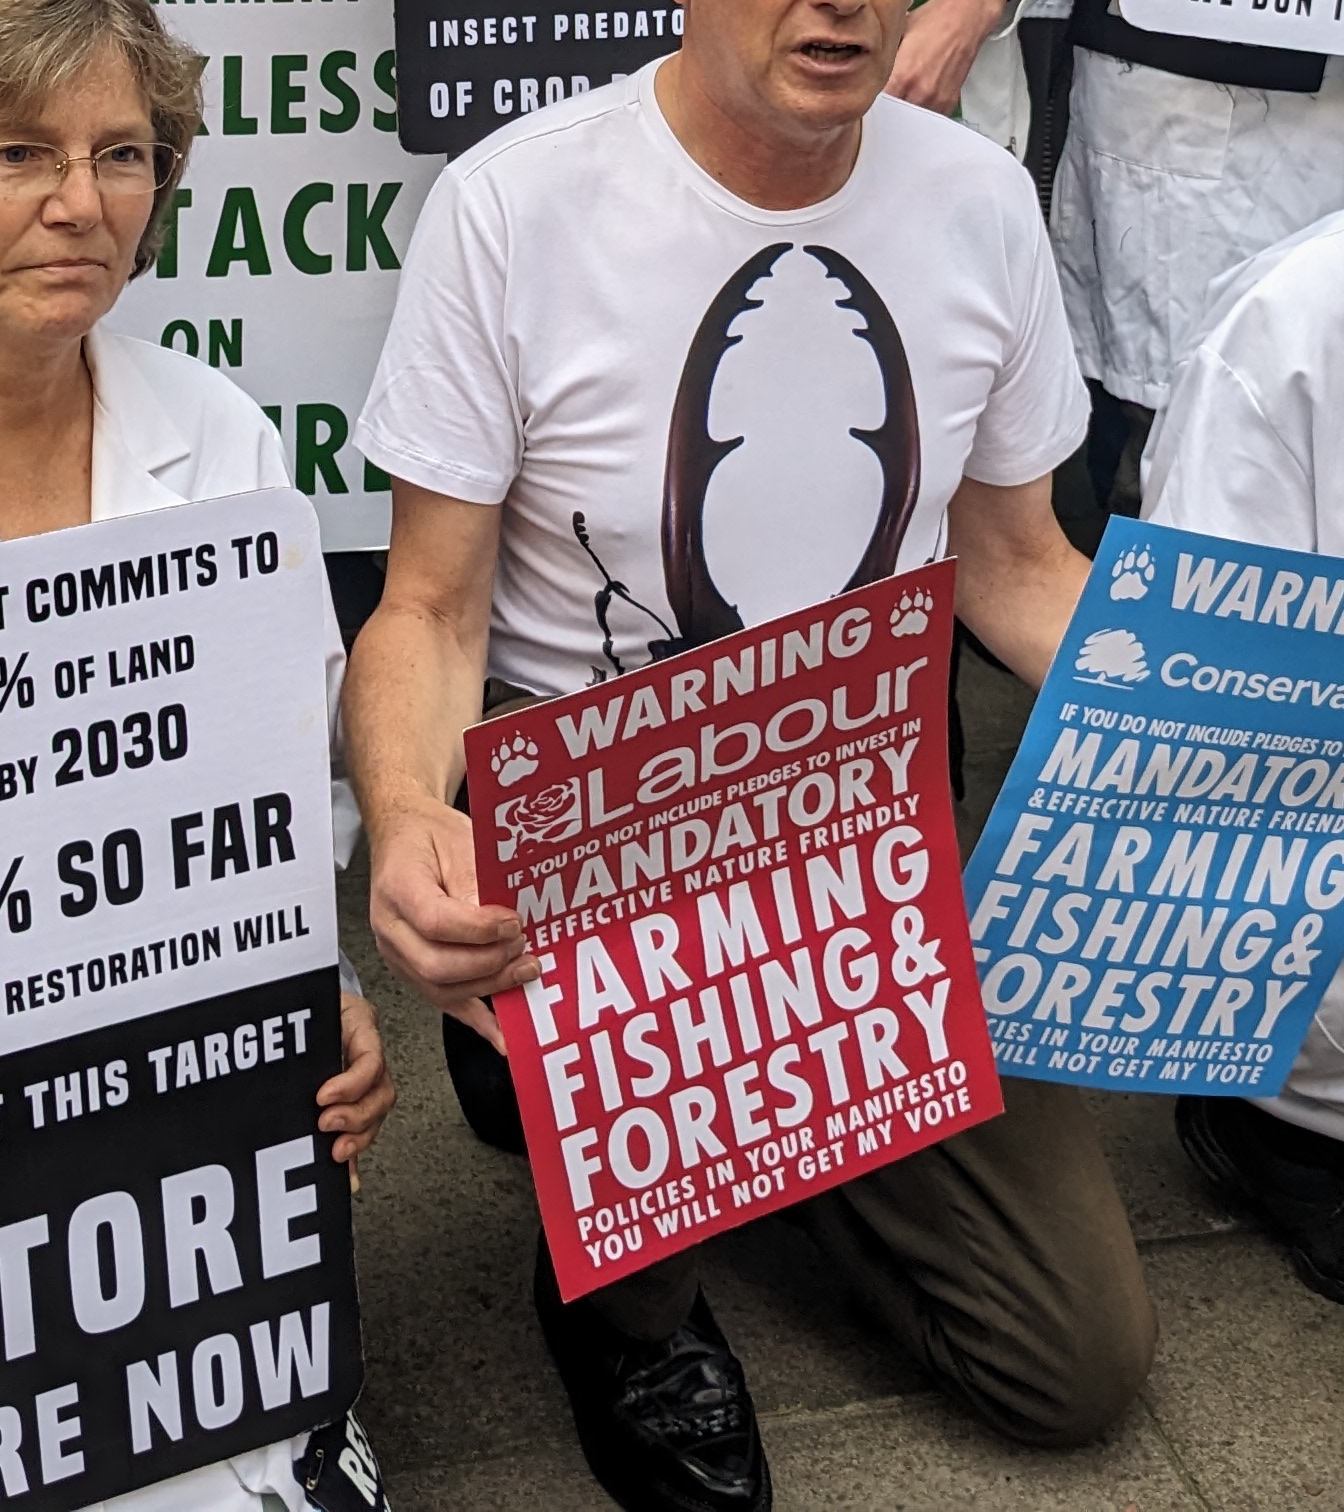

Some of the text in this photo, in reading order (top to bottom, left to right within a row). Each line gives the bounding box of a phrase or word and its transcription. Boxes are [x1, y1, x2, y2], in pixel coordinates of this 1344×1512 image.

[26, 543, 217, 623] COMMITS
[231, 531, 279, 578] TO
[556, 607, 872, 759] WARNING
[589, 656, 928, 829] Labour
[1059, 703, 1079, 721] IF
[1082, 706, 1118, 729] YOU
[1118, 714, 1146, 734] DO
[1148, 719, 1186, 739] NOT
[1185, 724, 1257, 747] INCLUDE
[1251, 732, 1319, 754] PLEDGES
[1321, 740, 1343, 756] TO
[56, 828, 144, 918] SO
[170, 792, 297, 888] FAR
[508, 718, 921, 888] IF YOU DO NOT INCLUDE PLEDGES TO INVEST IN
[515, 737, 920, 929] MANDATORY
[6, 932, 221, 1014] RESTORATION
[234, 905, 310, 952] WILL
[24, 1060, 130, 1128] THIS
[148, 1009, 312, 1094] TARGET
[560, 978, 951, 1212] FORESTRY
[578, 1061, 967, 1242] POLICIES IN YOUR MANIFESTO
[585, 1087, 972, 1268] YOU WILL NOT GET MY VOTE
